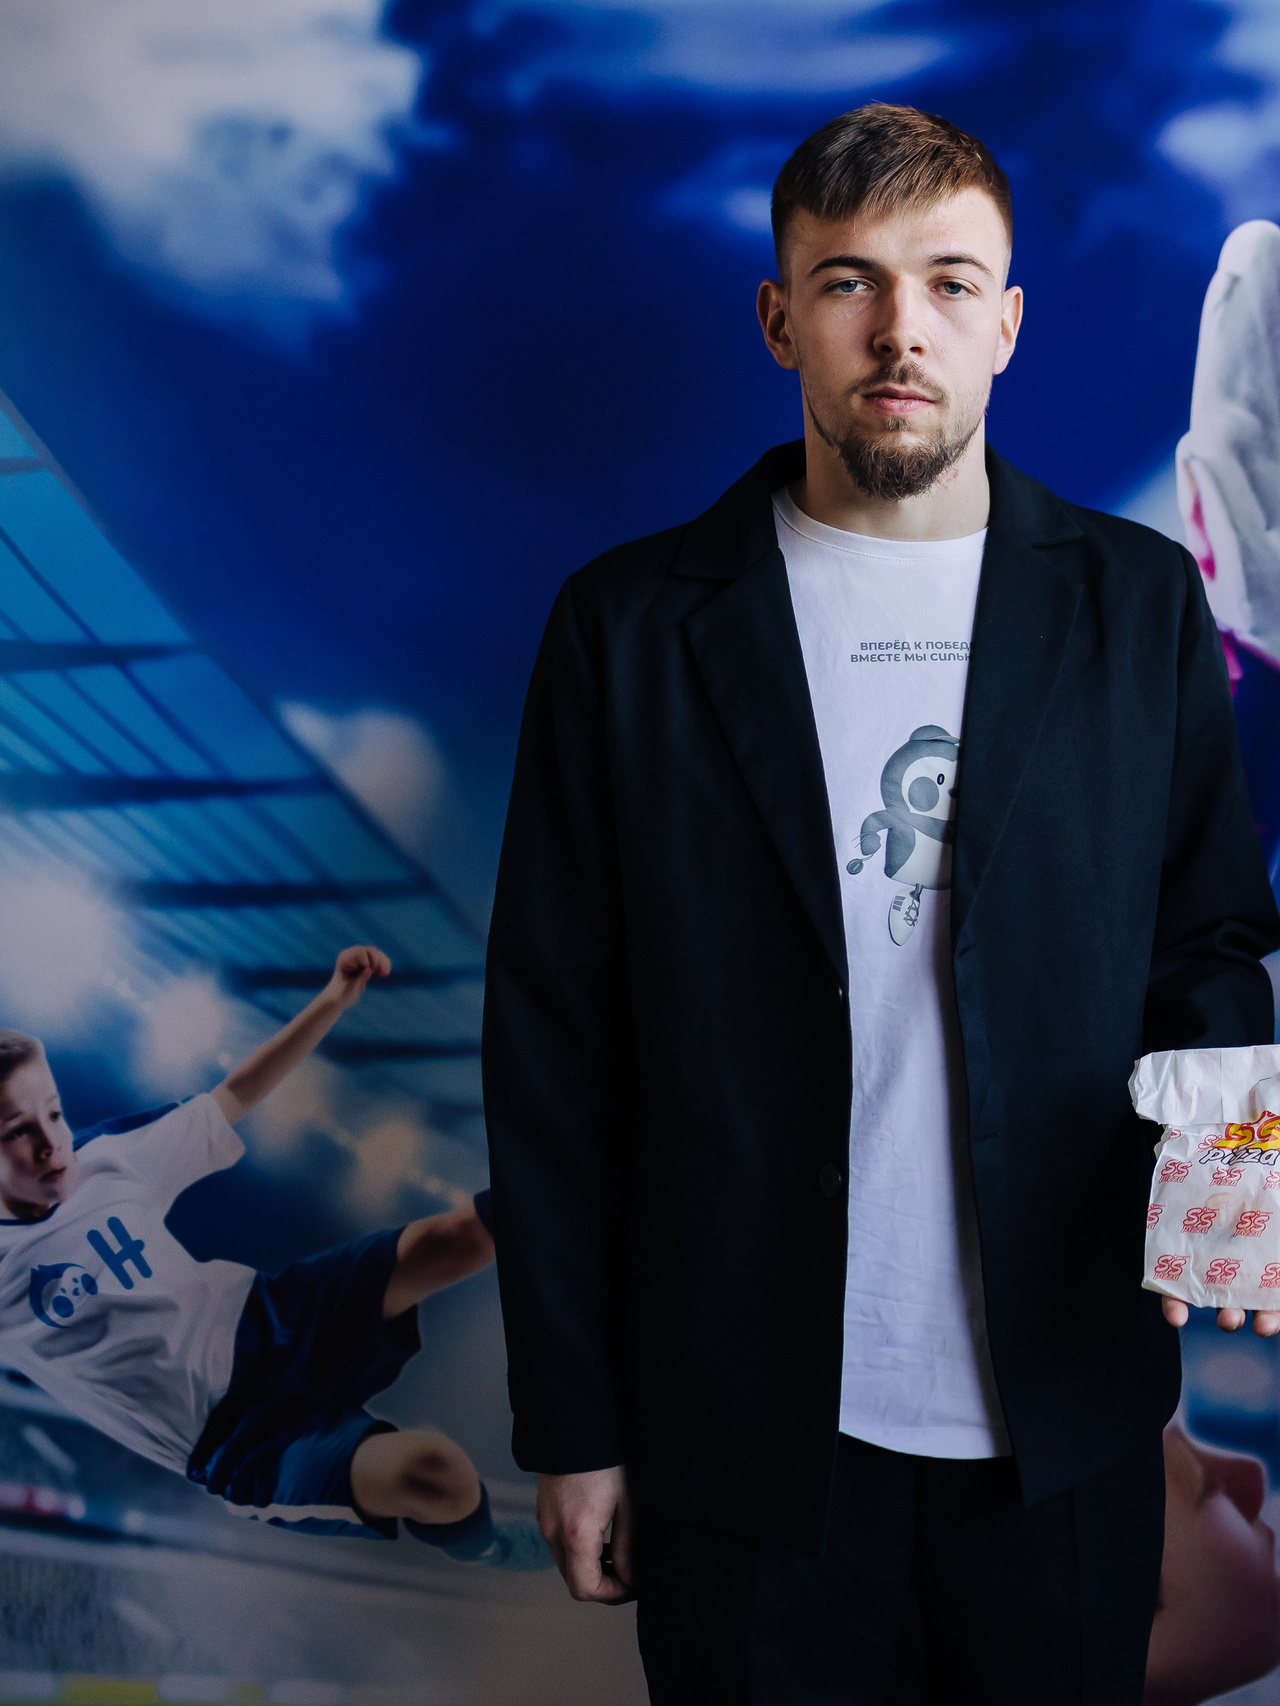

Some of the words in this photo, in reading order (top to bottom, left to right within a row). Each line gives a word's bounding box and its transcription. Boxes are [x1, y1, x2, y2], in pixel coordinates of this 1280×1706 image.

[860, 639, 911, 651] ВПЕРЁД
[914, 641, 922, 650] К
[926, 641, 971, 651] ПОБЕД
[850, 653, 901, 663] ВМЕСТЕ
[904, 653, 926, 662] МЫ
[1199, 1147, 1280, 1166] pizza
